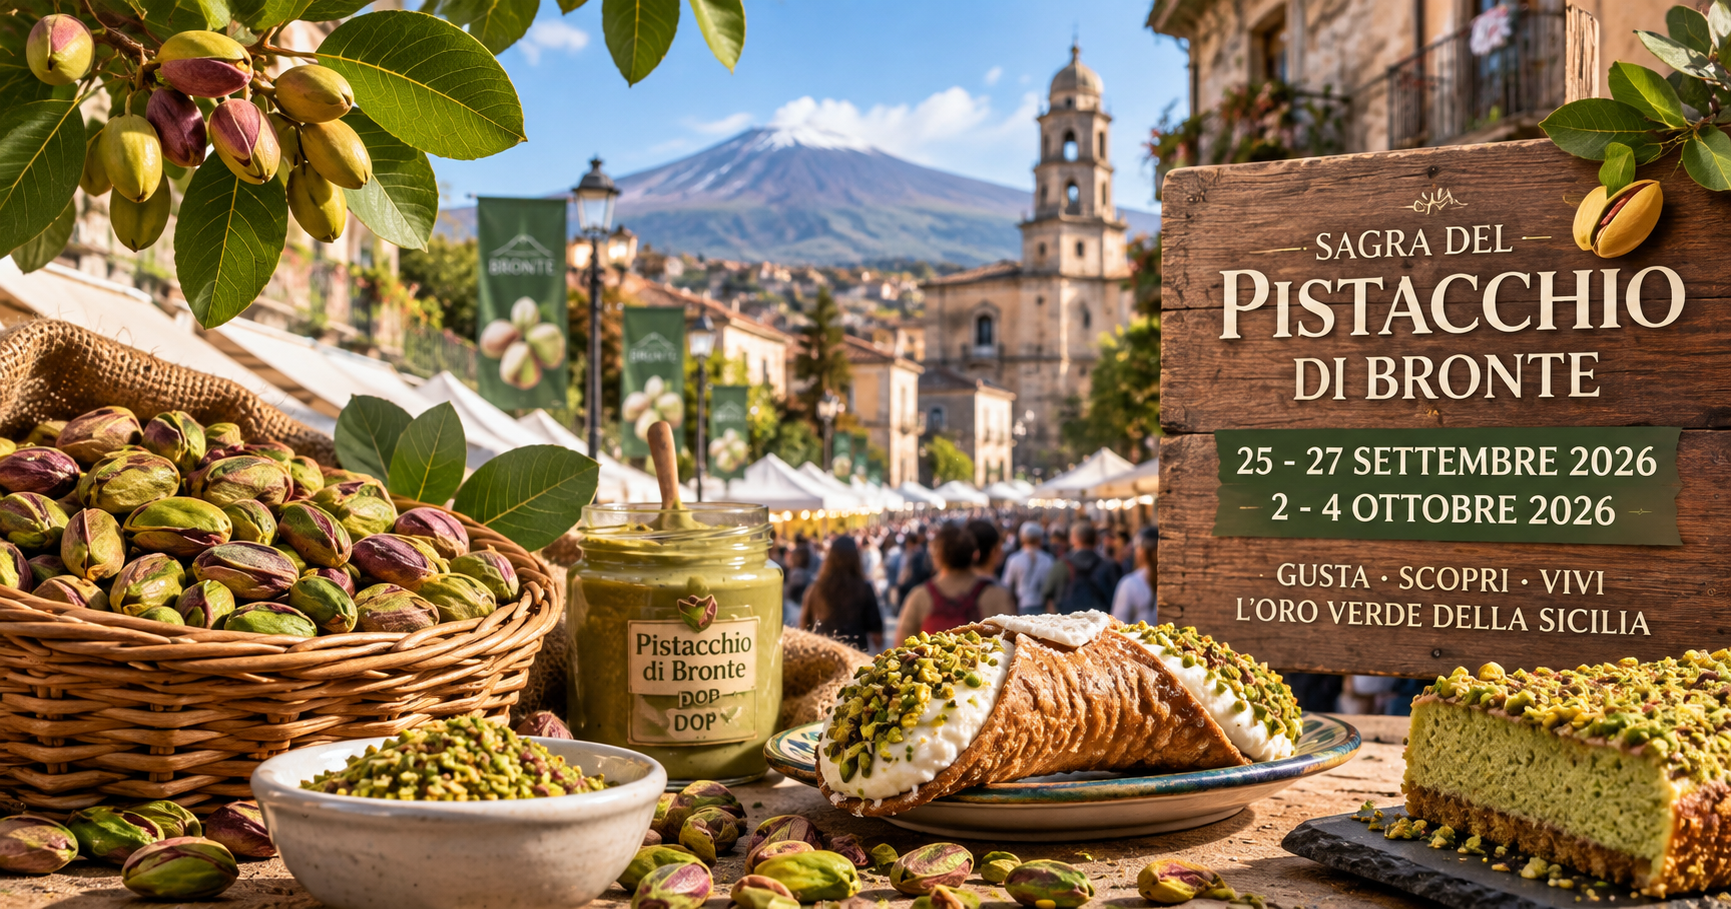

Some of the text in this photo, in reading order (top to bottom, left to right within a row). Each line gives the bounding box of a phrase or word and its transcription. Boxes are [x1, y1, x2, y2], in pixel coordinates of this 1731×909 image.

[1316, 225, 1512, 260] SAGRA DEL
[489, 258, 556, 276] BRONTE
[1219, 266, 1685, 339] PISTACCHIO
[1294, 352, 1599, 400] DI BRONTE
[1237, 447, 1272, 474] 25
[1306, 446, 1342, 475] 27
[1354, 447, 1557, 475] SETTEMBRE
[1570, 446, 1656, 476] 2026
[1272, 493, 1288, 520] 2
[1322, 494, 1341, 521] 4
[1353, 494, 1516, 523] OTTOBRE
[1529, 495, 1615, 525] 2026
[1277, 563, 1369, 588] GUSTA
[1400, 566, 1508, 592] SCOPRI
[1540, 570, 1603, 594] VIVI
[1237, 598, 1650, 635] L’ORO VERDE DELLA SICILIA
[636, 632, 751, 656] Pistacchio
[643, 660, 745, 681] di Bronte
[675, 712, 716, 731] DOP
